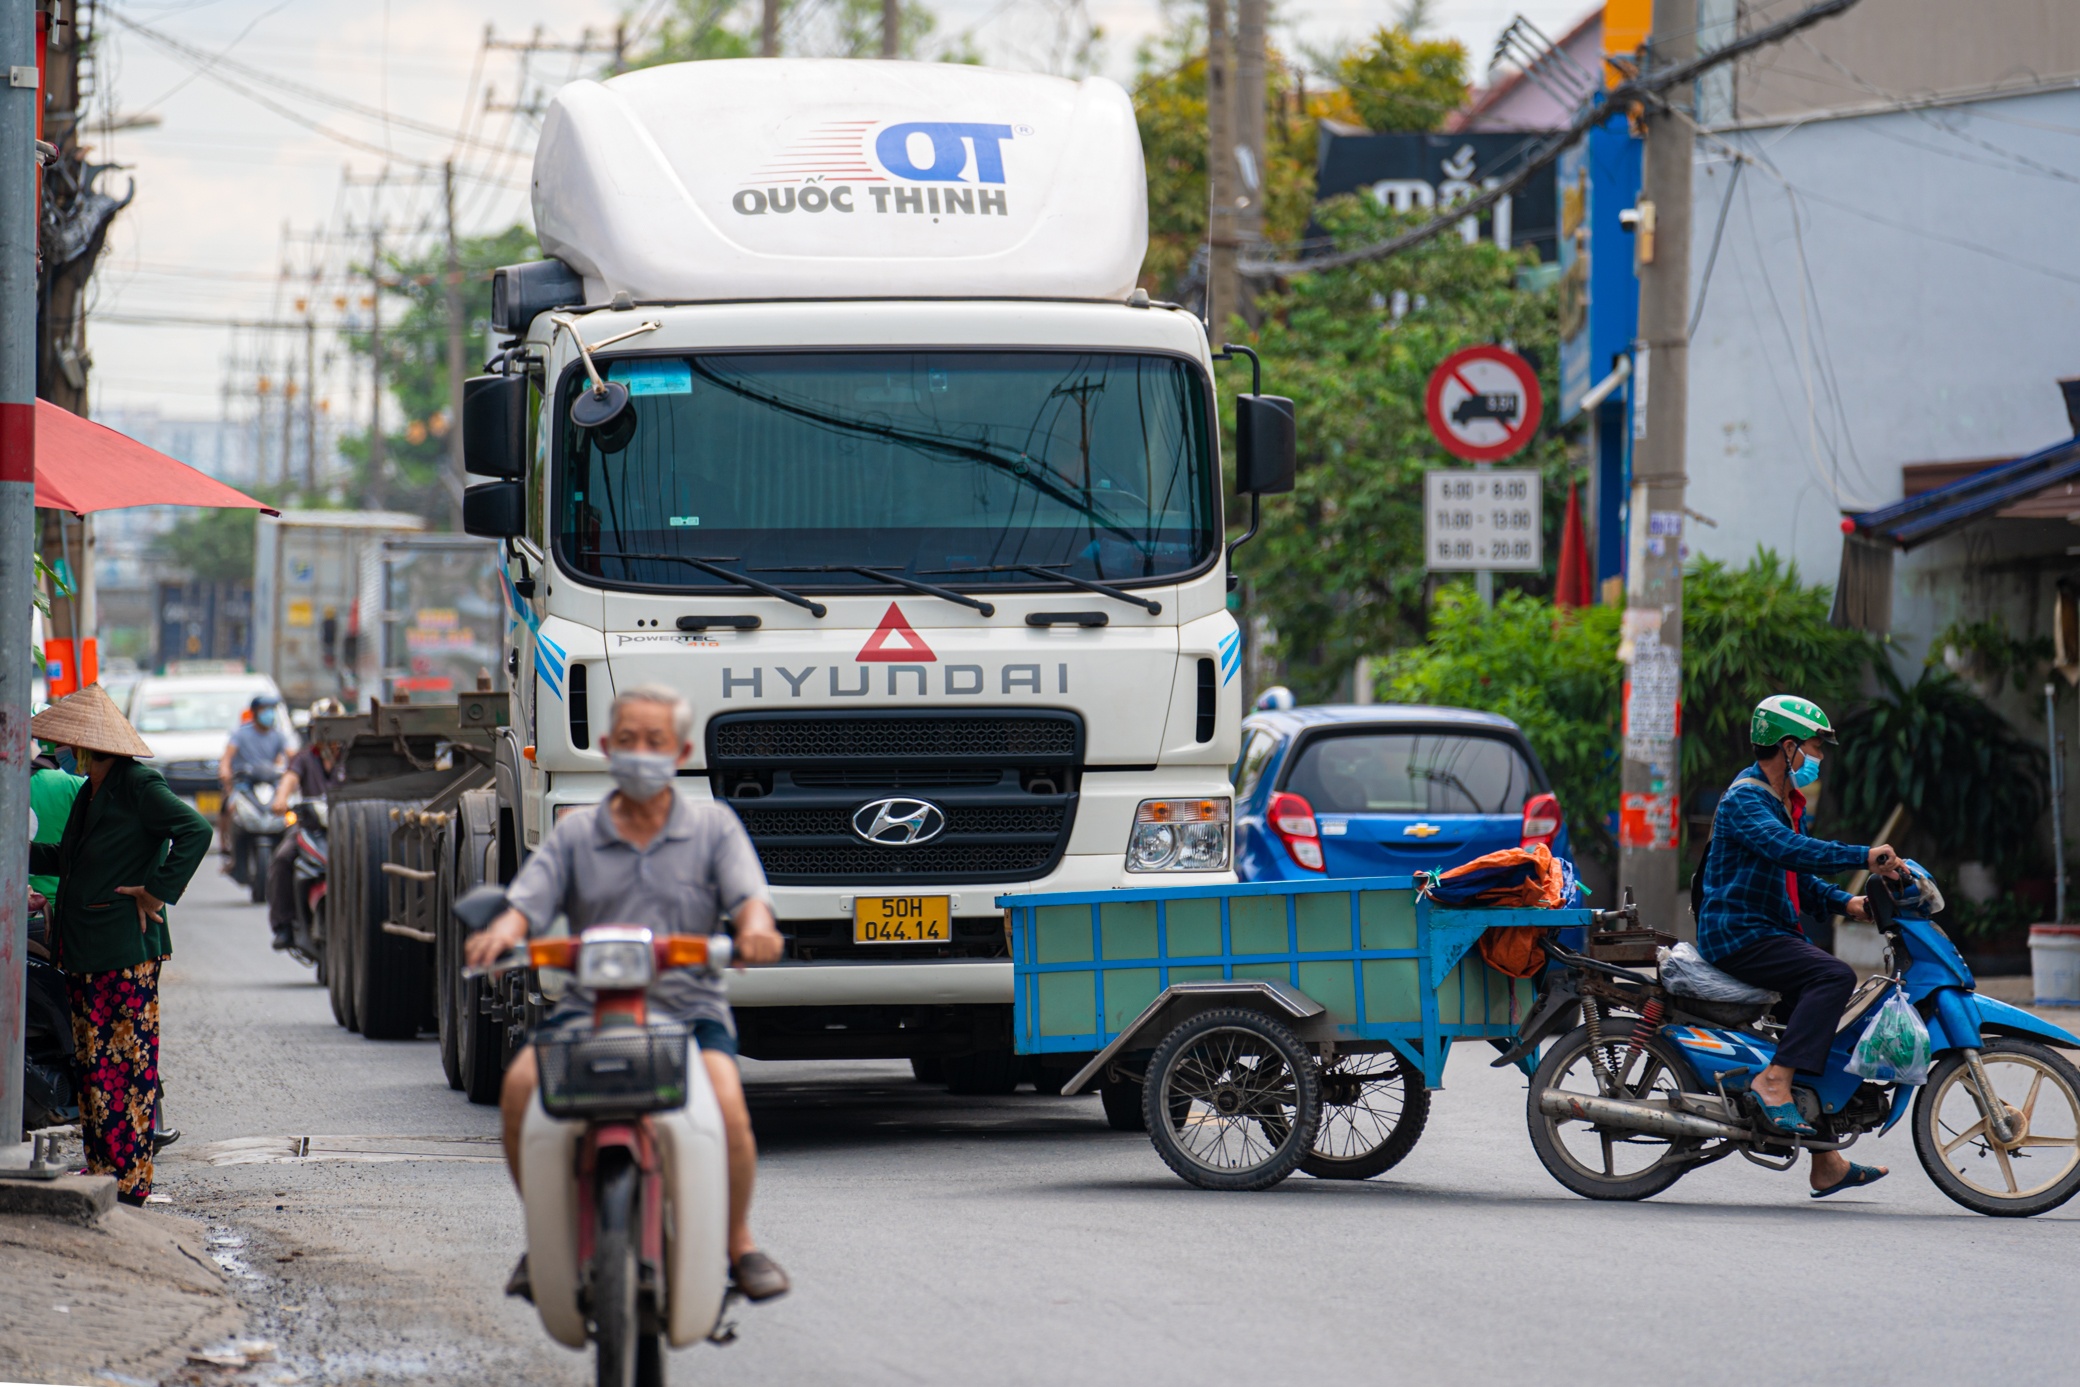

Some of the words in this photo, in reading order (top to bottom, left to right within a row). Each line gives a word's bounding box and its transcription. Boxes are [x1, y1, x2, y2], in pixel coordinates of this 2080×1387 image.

[875, 121, 1014, 184] QT
[732, 175, 853, 214] QUỐC
[869, 186, 1008, 224] THỊNH
[617, 635, 717, 647] POWERTEC
[723, 663, 1067, 699] HYUNDAI
[881, 898, 922, 918] 50H
[865, 920, 939, 941] 044.14
